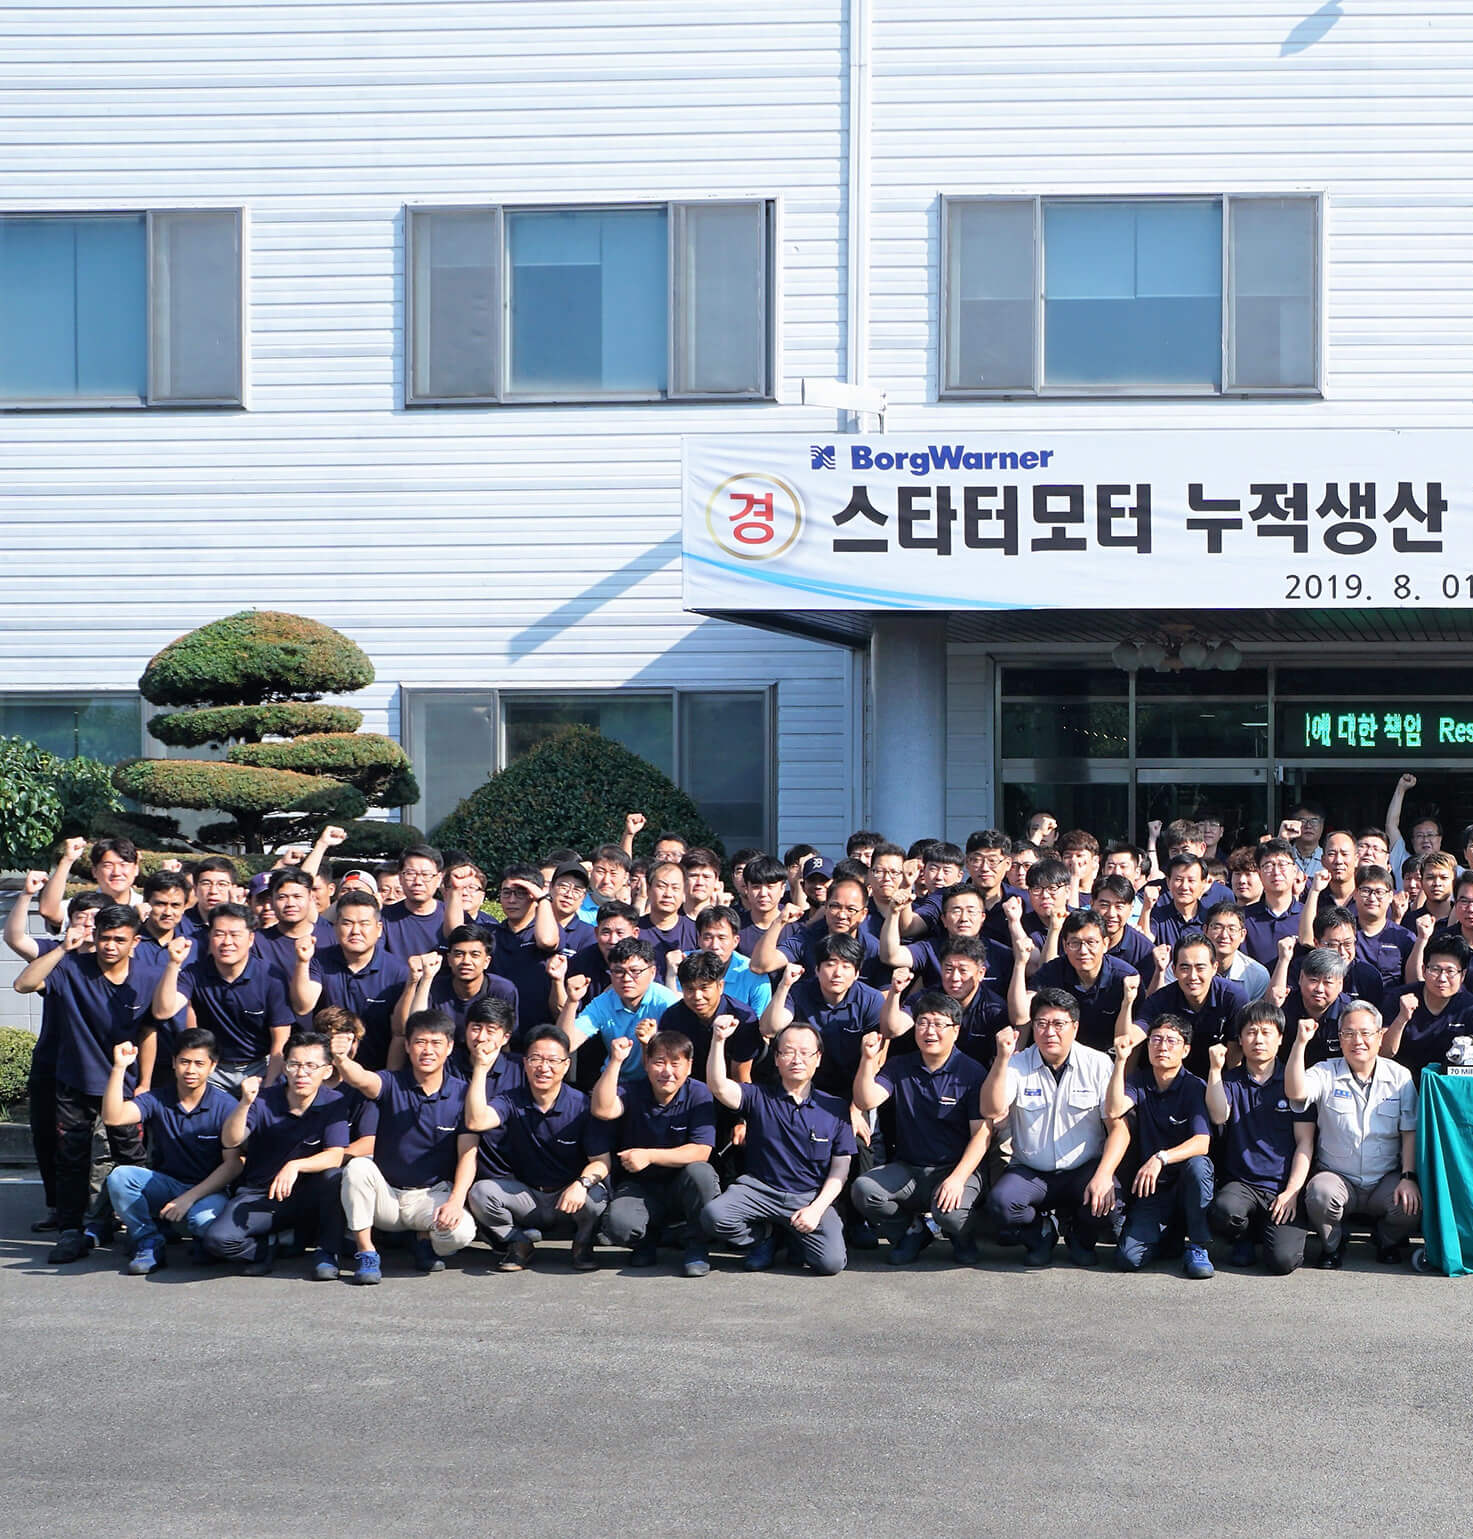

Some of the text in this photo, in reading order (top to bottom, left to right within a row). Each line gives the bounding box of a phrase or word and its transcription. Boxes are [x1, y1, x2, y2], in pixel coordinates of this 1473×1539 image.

[850, 444, 1054, 476] BorgWarner
[728, 492, 775, 546] 경
[832, 483, 1152, 556] 스타터모터
[1186, 481, 1448, 555] 누적생산
[1285, 574, 1372, 601] 2019.
[1393, 573, 1420, 601] 8.
[1337, 712, 1379, 747] 대한
[1383, 712, 1422, 747] 책임
[1450, 1067, 1460, 1076] 70
